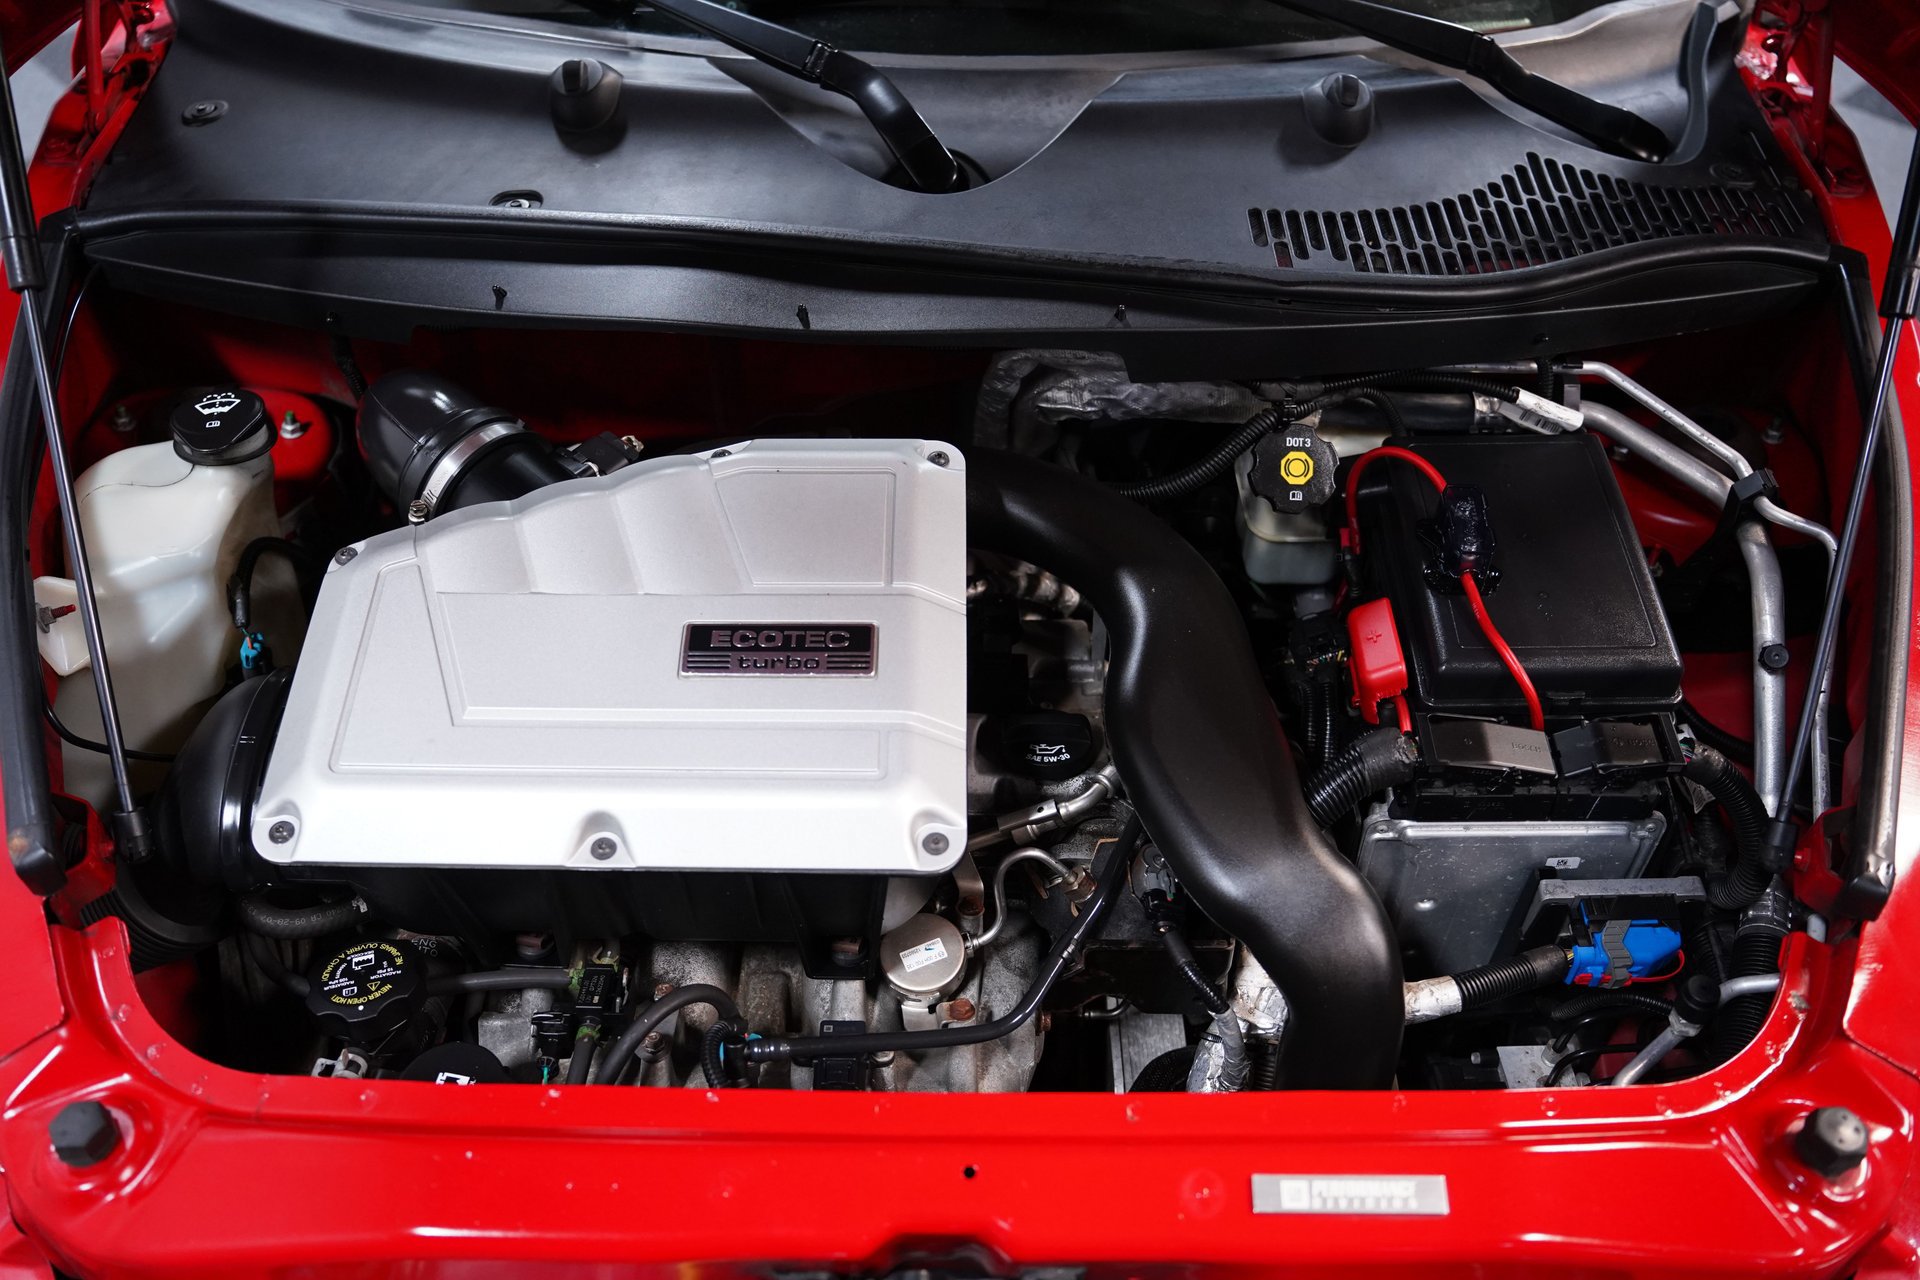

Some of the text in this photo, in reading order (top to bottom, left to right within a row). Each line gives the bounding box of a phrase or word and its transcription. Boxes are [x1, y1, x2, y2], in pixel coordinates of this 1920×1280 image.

[1286, 437, 1311, 447] DOT 3
[710, 630, 850, 648] ECOTEC
[738, 655, 820, 669] turbo
[1026, 753, 1071, 763] SAE 5W-30
[346, 942, 378, 955] OUVRIR
[380, 943, 401, 957] JAMAIS
[394, 956, 404, 965] NE
[370, 970, 402, 980] RADIATOR
[323, 980, 355, 990] RADIATEUR
[367, 983, 393, 1001] NEVER
[346, 996, 368, 1004] OPEN
